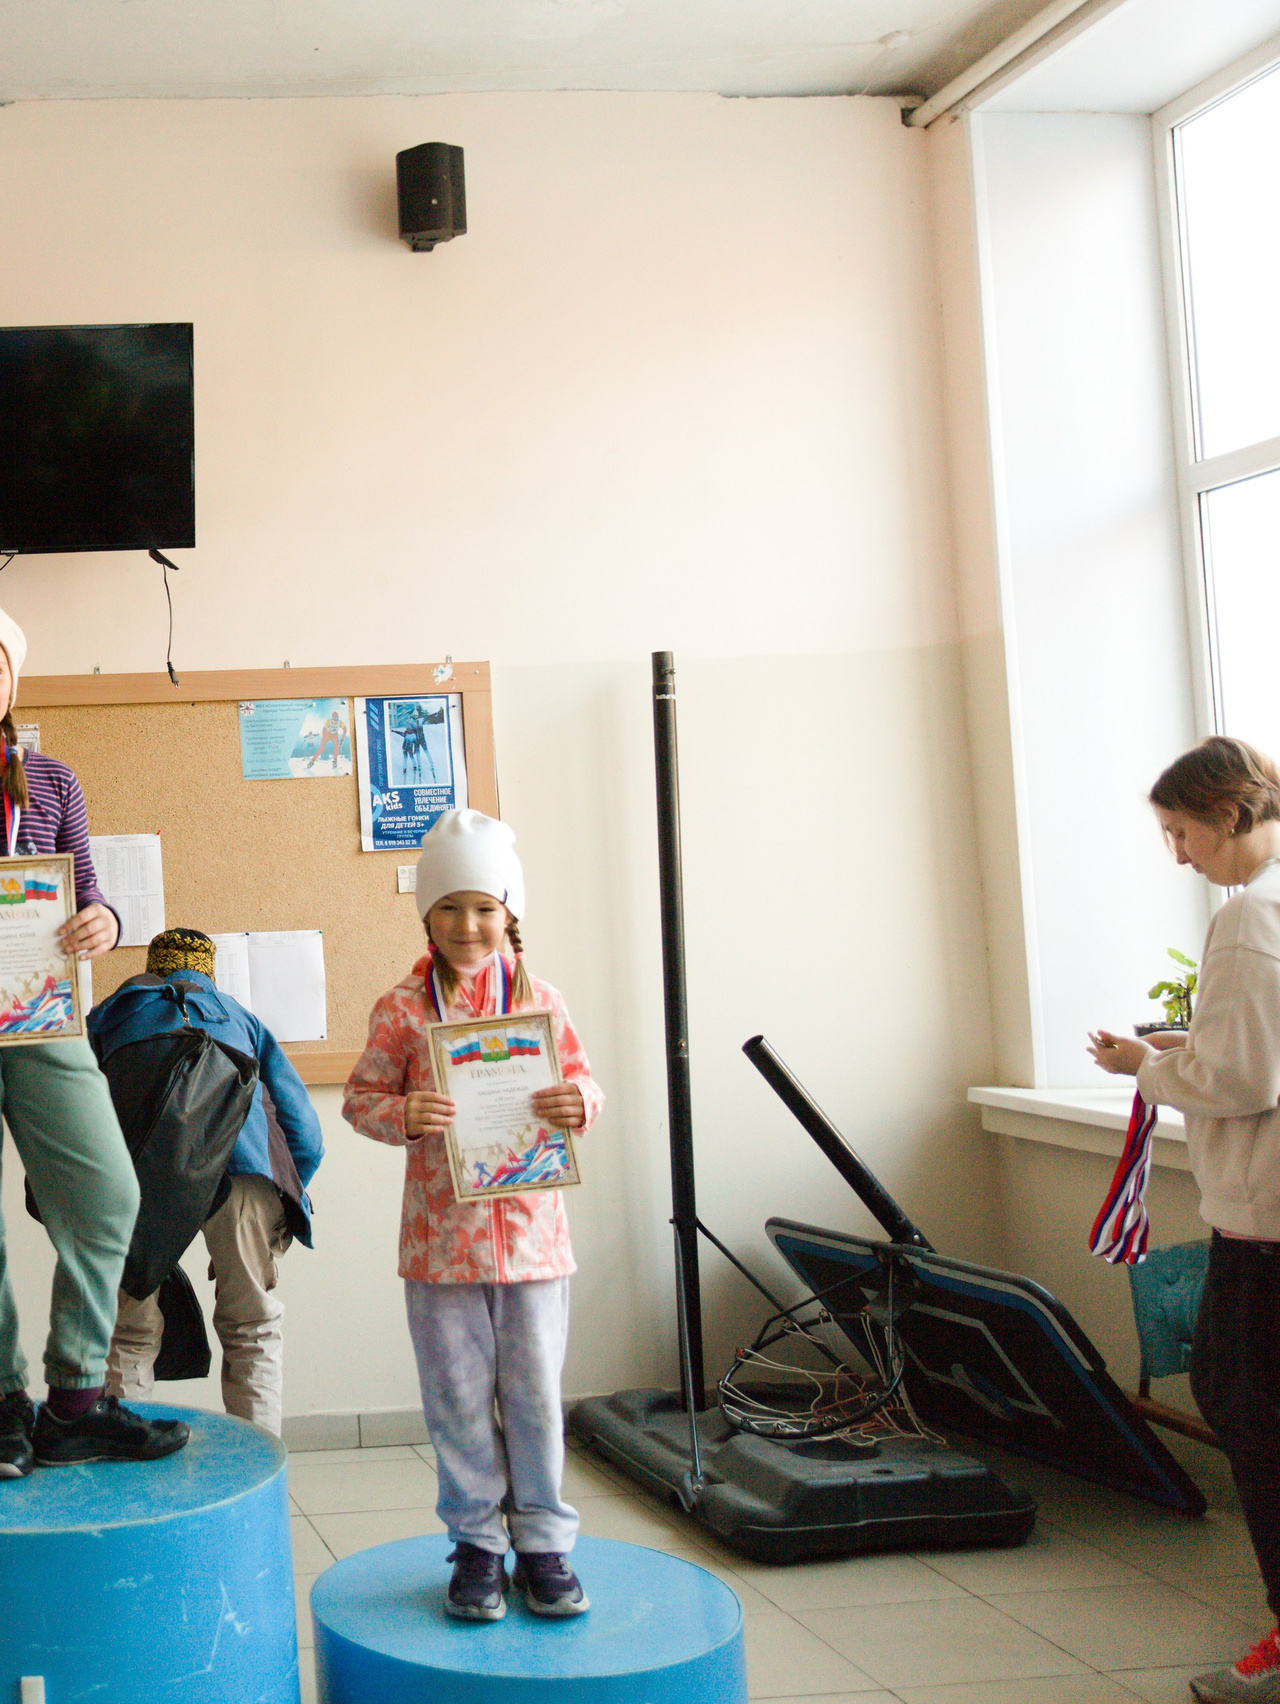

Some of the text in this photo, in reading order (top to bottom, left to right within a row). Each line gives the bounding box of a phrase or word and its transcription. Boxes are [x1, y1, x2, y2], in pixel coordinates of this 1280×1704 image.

[414, 788, 452, 796] СОВМЕСТНОЕ
[372, 791, 400, 806] AKS
[414, 796, 447, 804] УВЛЕЧЕНИЕ
[386, 802, 402, 811] kids
[470, 1064, 526, 1079] ГРАМОТА
